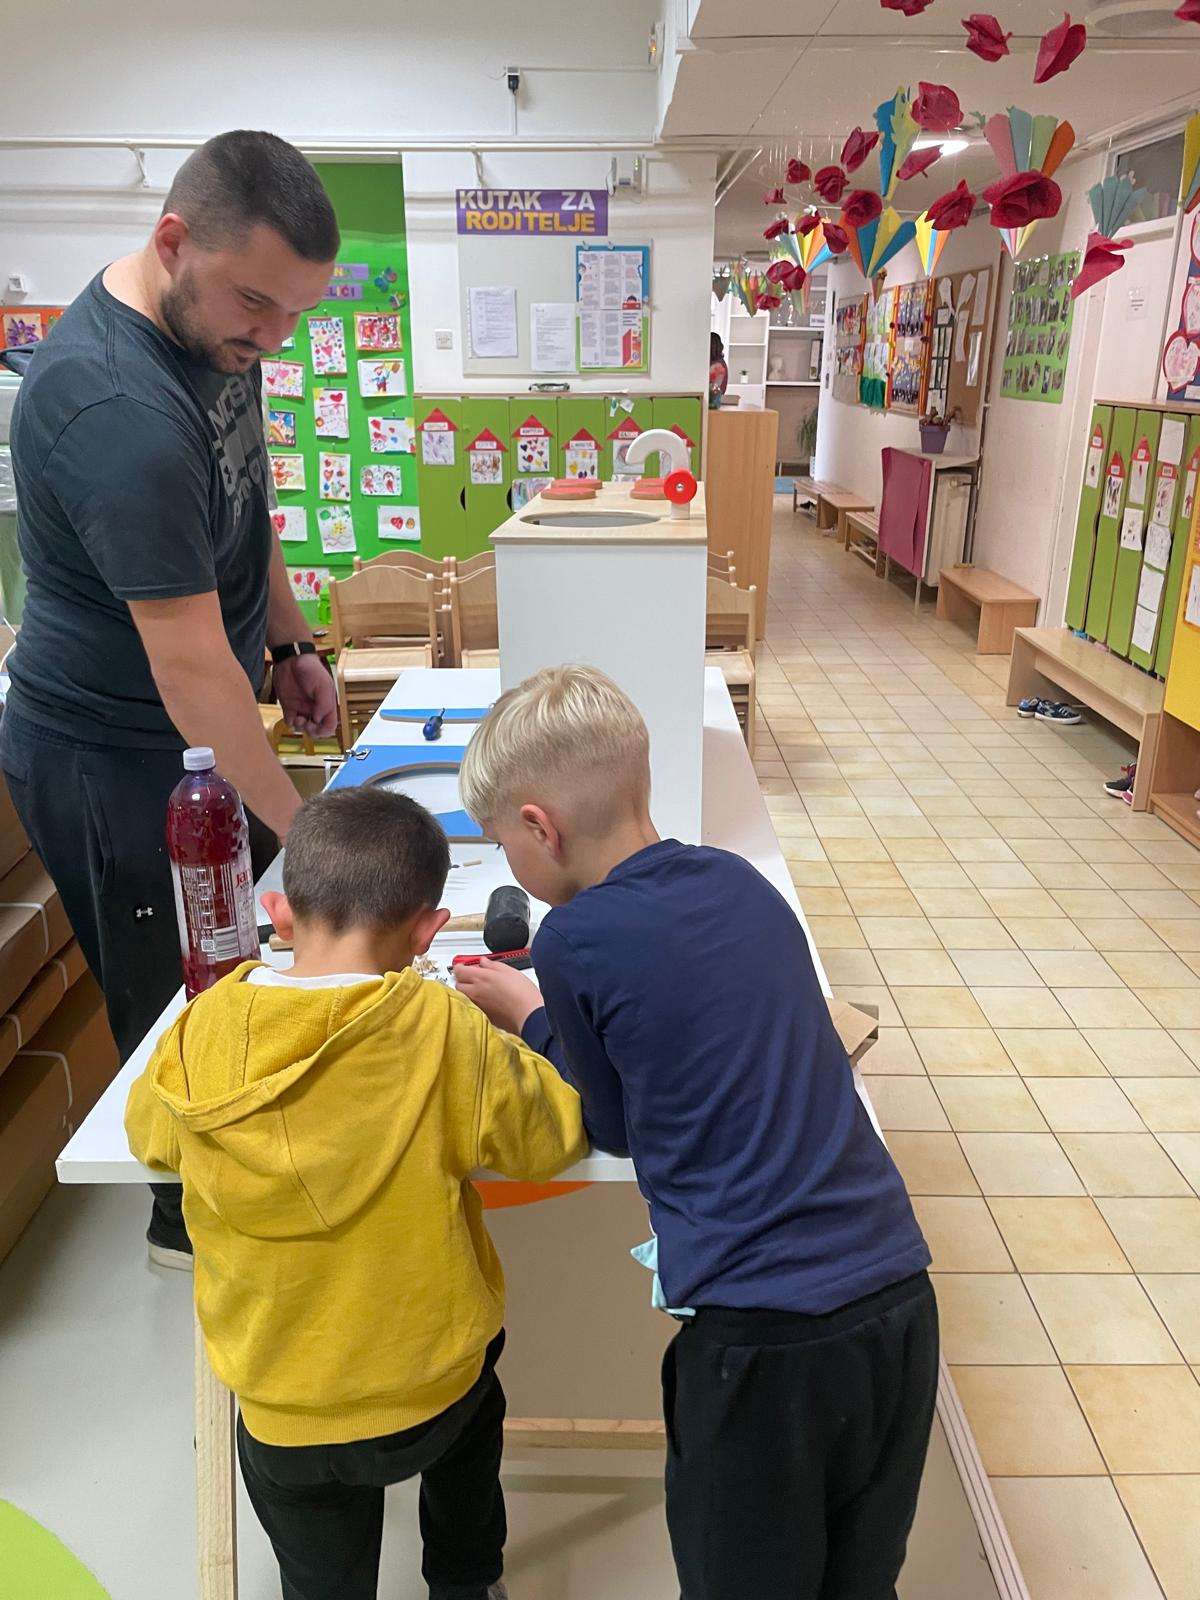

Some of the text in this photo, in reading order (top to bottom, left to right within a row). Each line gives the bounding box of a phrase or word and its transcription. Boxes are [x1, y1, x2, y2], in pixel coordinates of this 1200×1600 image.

[459, 190, 596, 211] KUTAK ZA
[466, 211, 596, 232] RODITELJE
